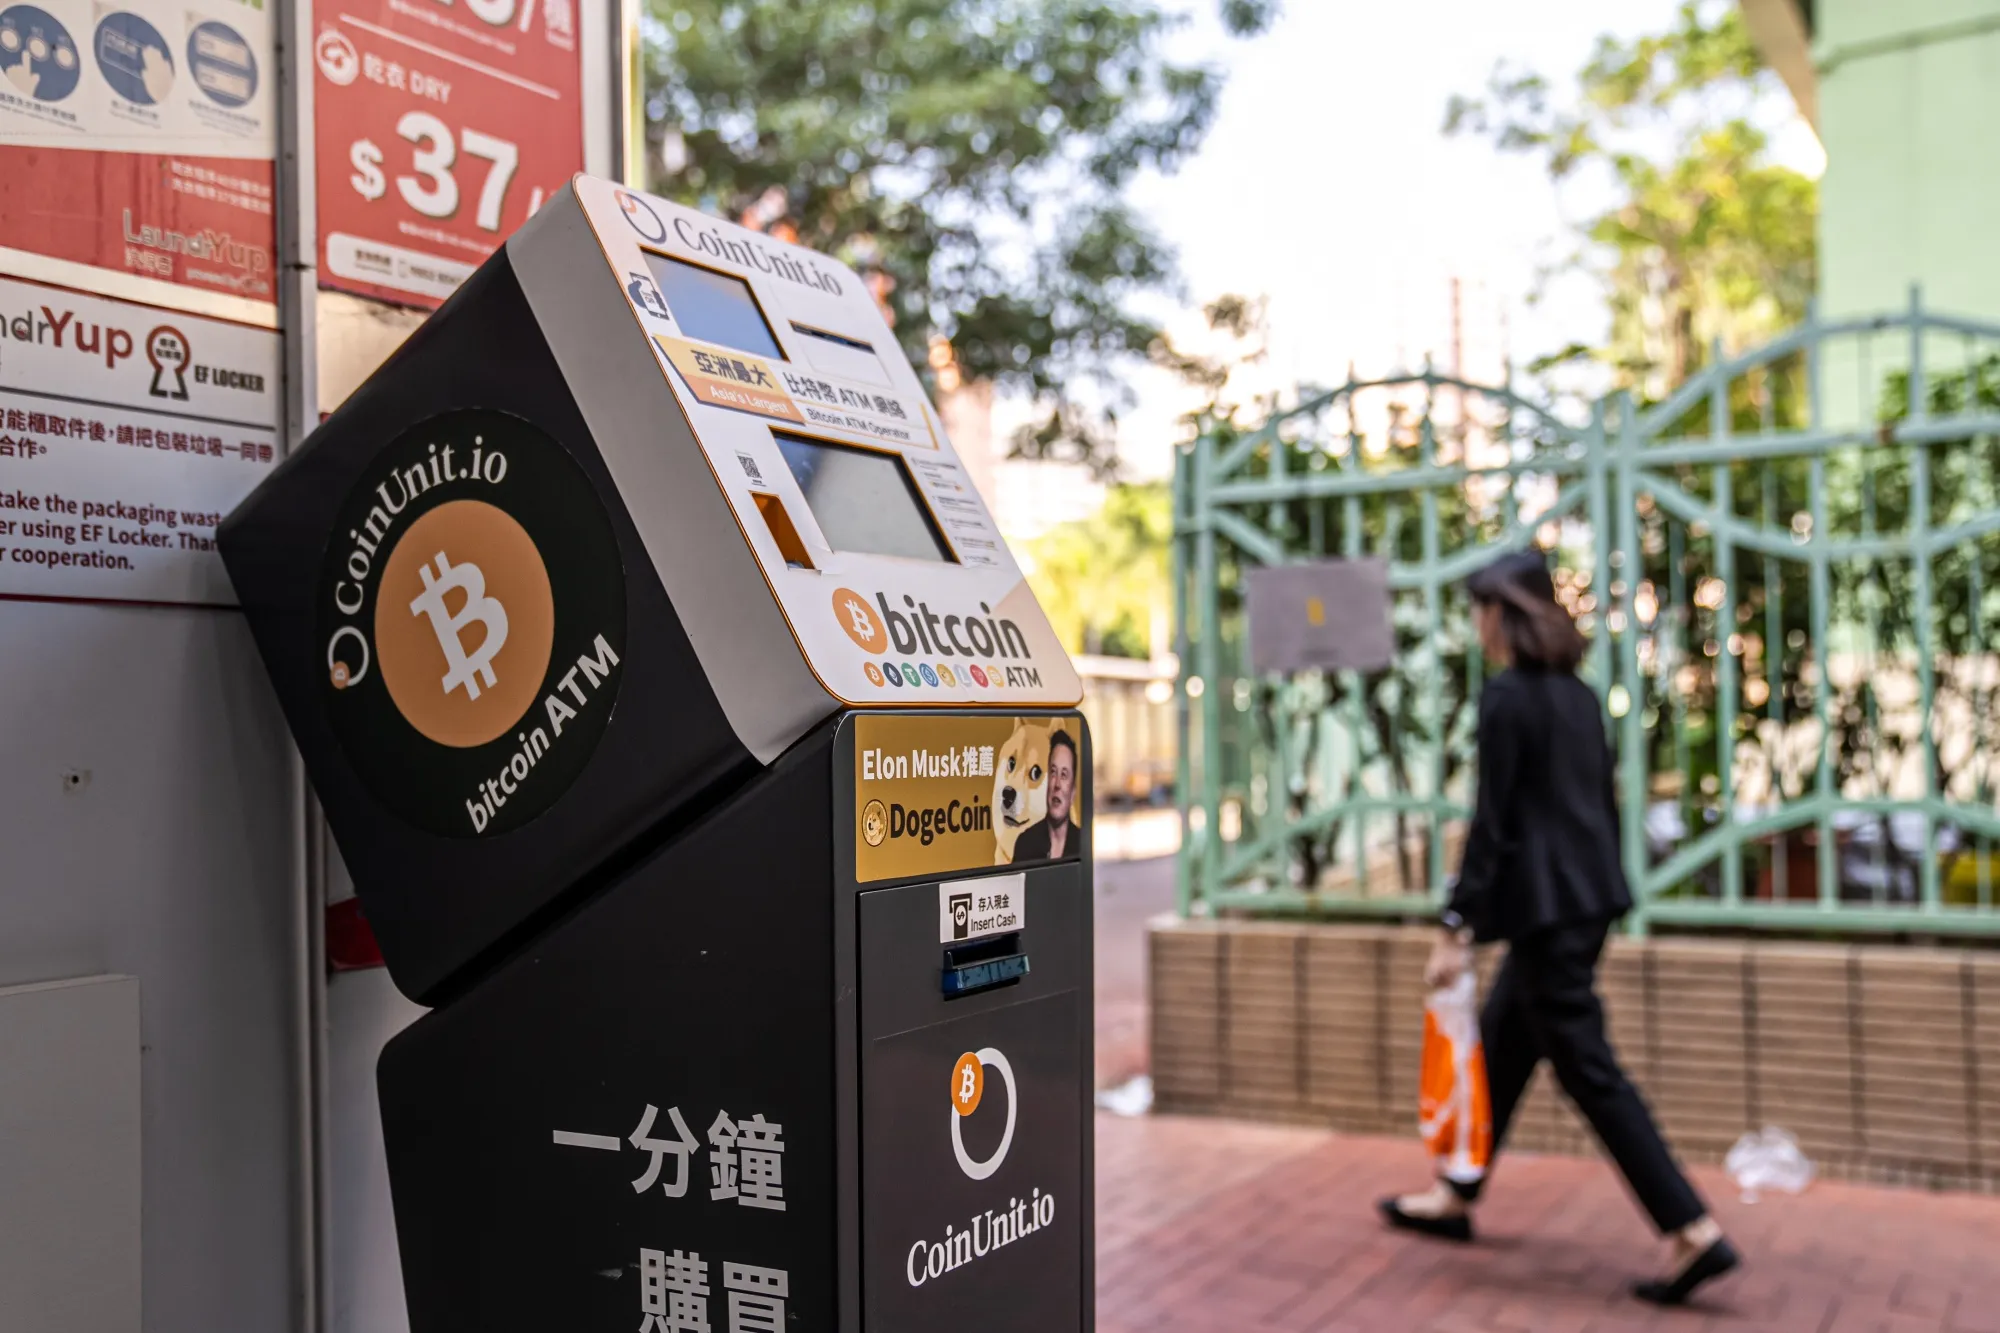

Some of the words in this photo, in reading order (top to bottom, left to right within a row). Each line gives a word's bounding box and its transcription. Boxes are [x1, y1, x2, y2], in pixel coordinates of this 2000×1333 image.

[409, 69, 452, 105] DRY
[673, 217, 844, 297] CoinUnit.io
[194, 364, 210, 384] EF
[212, 367, 265, 394] LOCKER
[690, 349, 774, 389] 亞洲最大
[710, 384, 746, 405] Asia's
[749, 392, 791, 415] Largest
[782, 371, 838, 404] 比特幣
[839, 388, 874, 411] ATM
[806, 408, 844, 427] Bitcoin
[845, 415, 867, 431] ATM
[868, 420, 911, 441] Operator
[45, 493, 77, 515] the
[82, 500, 178, 529] packaging
[180, 511, 222, 527] wast
[336, 435, 508, 615] CoinUnit.io
[22, 519, 77, 545] using
[81, 523, 103, 542] EF
[108, 526, 174, 549] Locker.
[11, 547, 135, 570] cooperation.
[876, 591, 1031, 660] bitcoin
[1005, 666, 1043, 689] ATM
[466, 728, 550, 834] bitcoin
[544, 633, 621, 738] ATM
[862, 748, 908, 780] Elon
[890, 795, 992, 846] DogeCoin
[978, 893, 1010, 912] 存入現金
[970, 916, 995, 932] Insert
[996, 912, 1017, 928] Cash
[552, 1103, 787, 1212] 一分鐘
[907, 1187, 1055, 1287] CoinUnit.io
[638, 1247, 789, 1333] 購買
